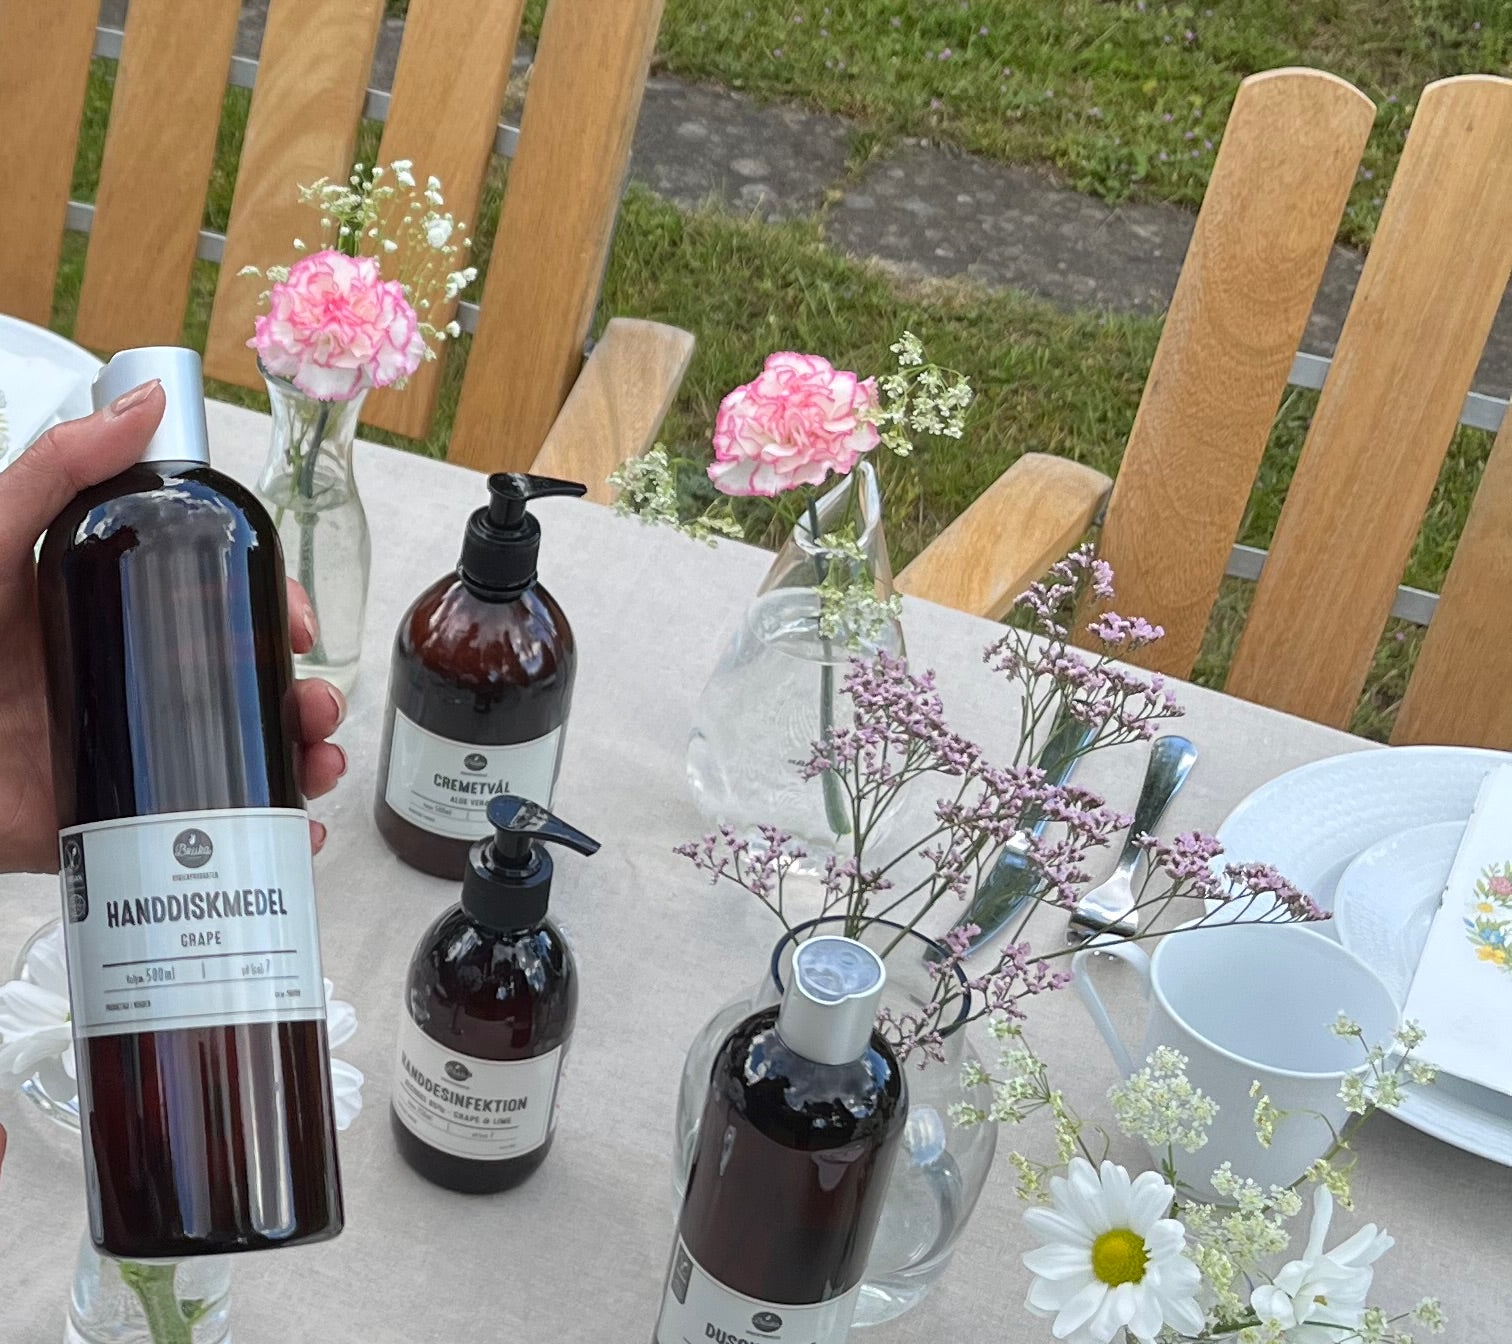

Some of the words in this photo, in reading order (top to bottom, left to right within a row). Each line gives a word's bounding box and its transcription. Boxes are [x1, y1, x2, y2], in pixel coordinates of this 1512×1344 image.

[433, 773, 510, 795] CREMETVÅL
[106, 888, 288, 929] HANDDISKMEDEL
[180, 930, 222, 948] GRAPE
[146, 966, 175, 982] 500ml
